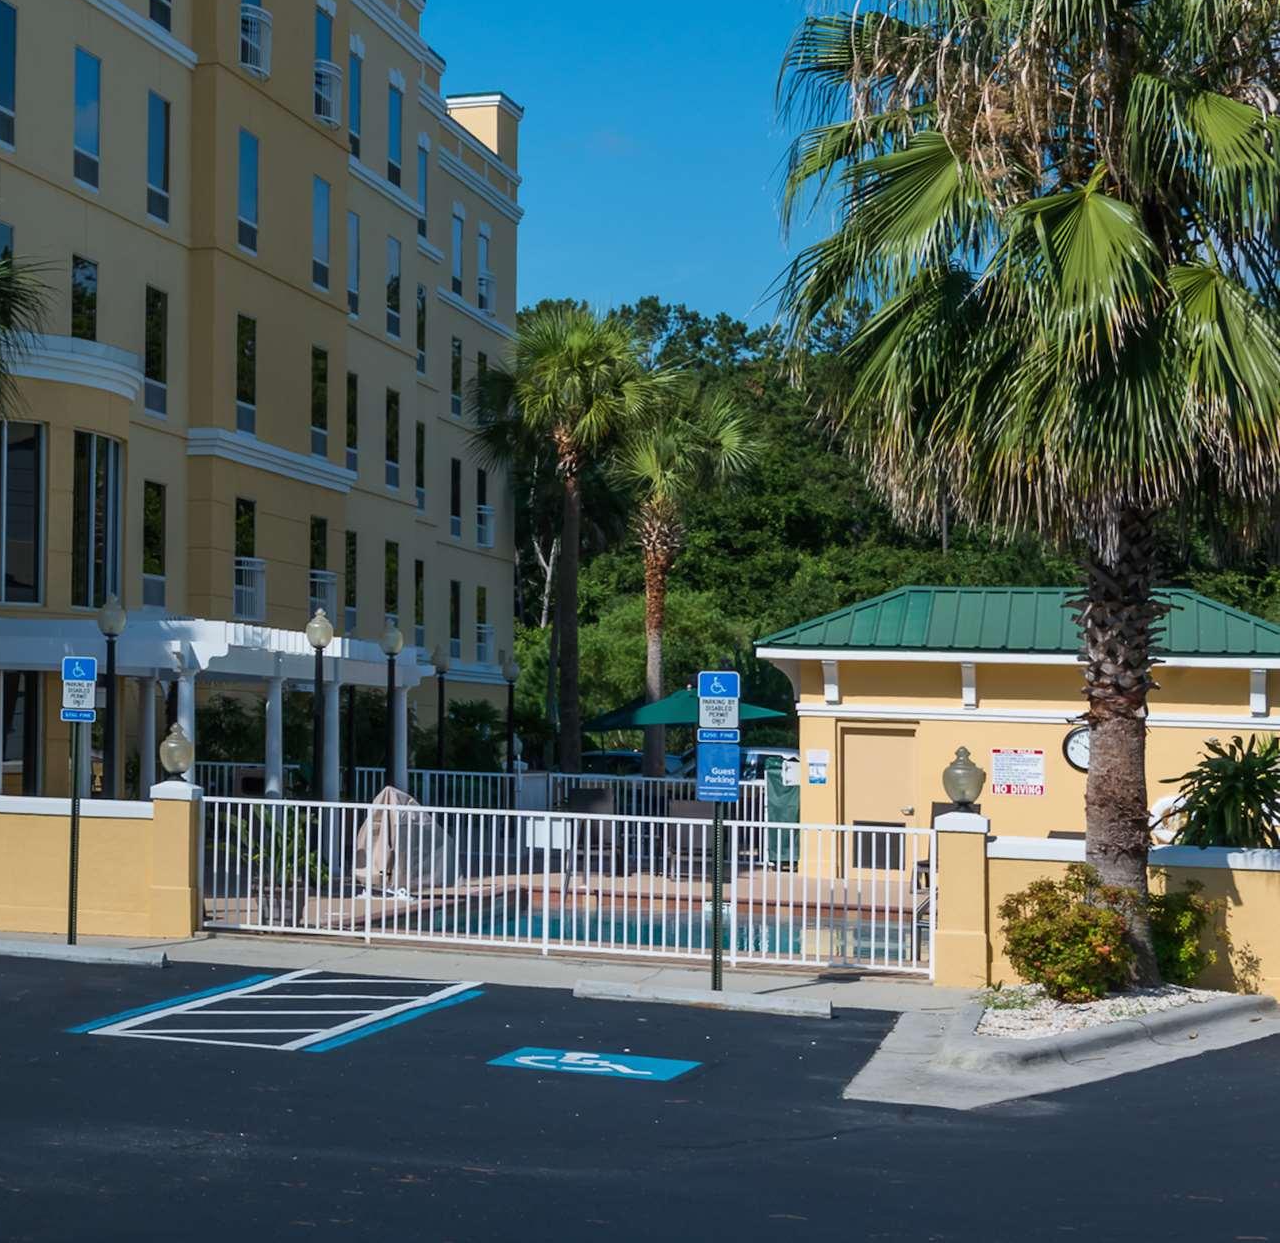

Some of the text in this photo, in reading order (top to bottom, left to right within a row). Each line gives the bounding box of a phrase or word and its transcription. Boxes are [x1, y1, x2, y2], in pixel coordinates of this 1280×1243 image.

[711, 766, 736, 776] Guest
[704, 775, 736, 786] Parking
[994, 784, 1042, 795] NO DIVING
